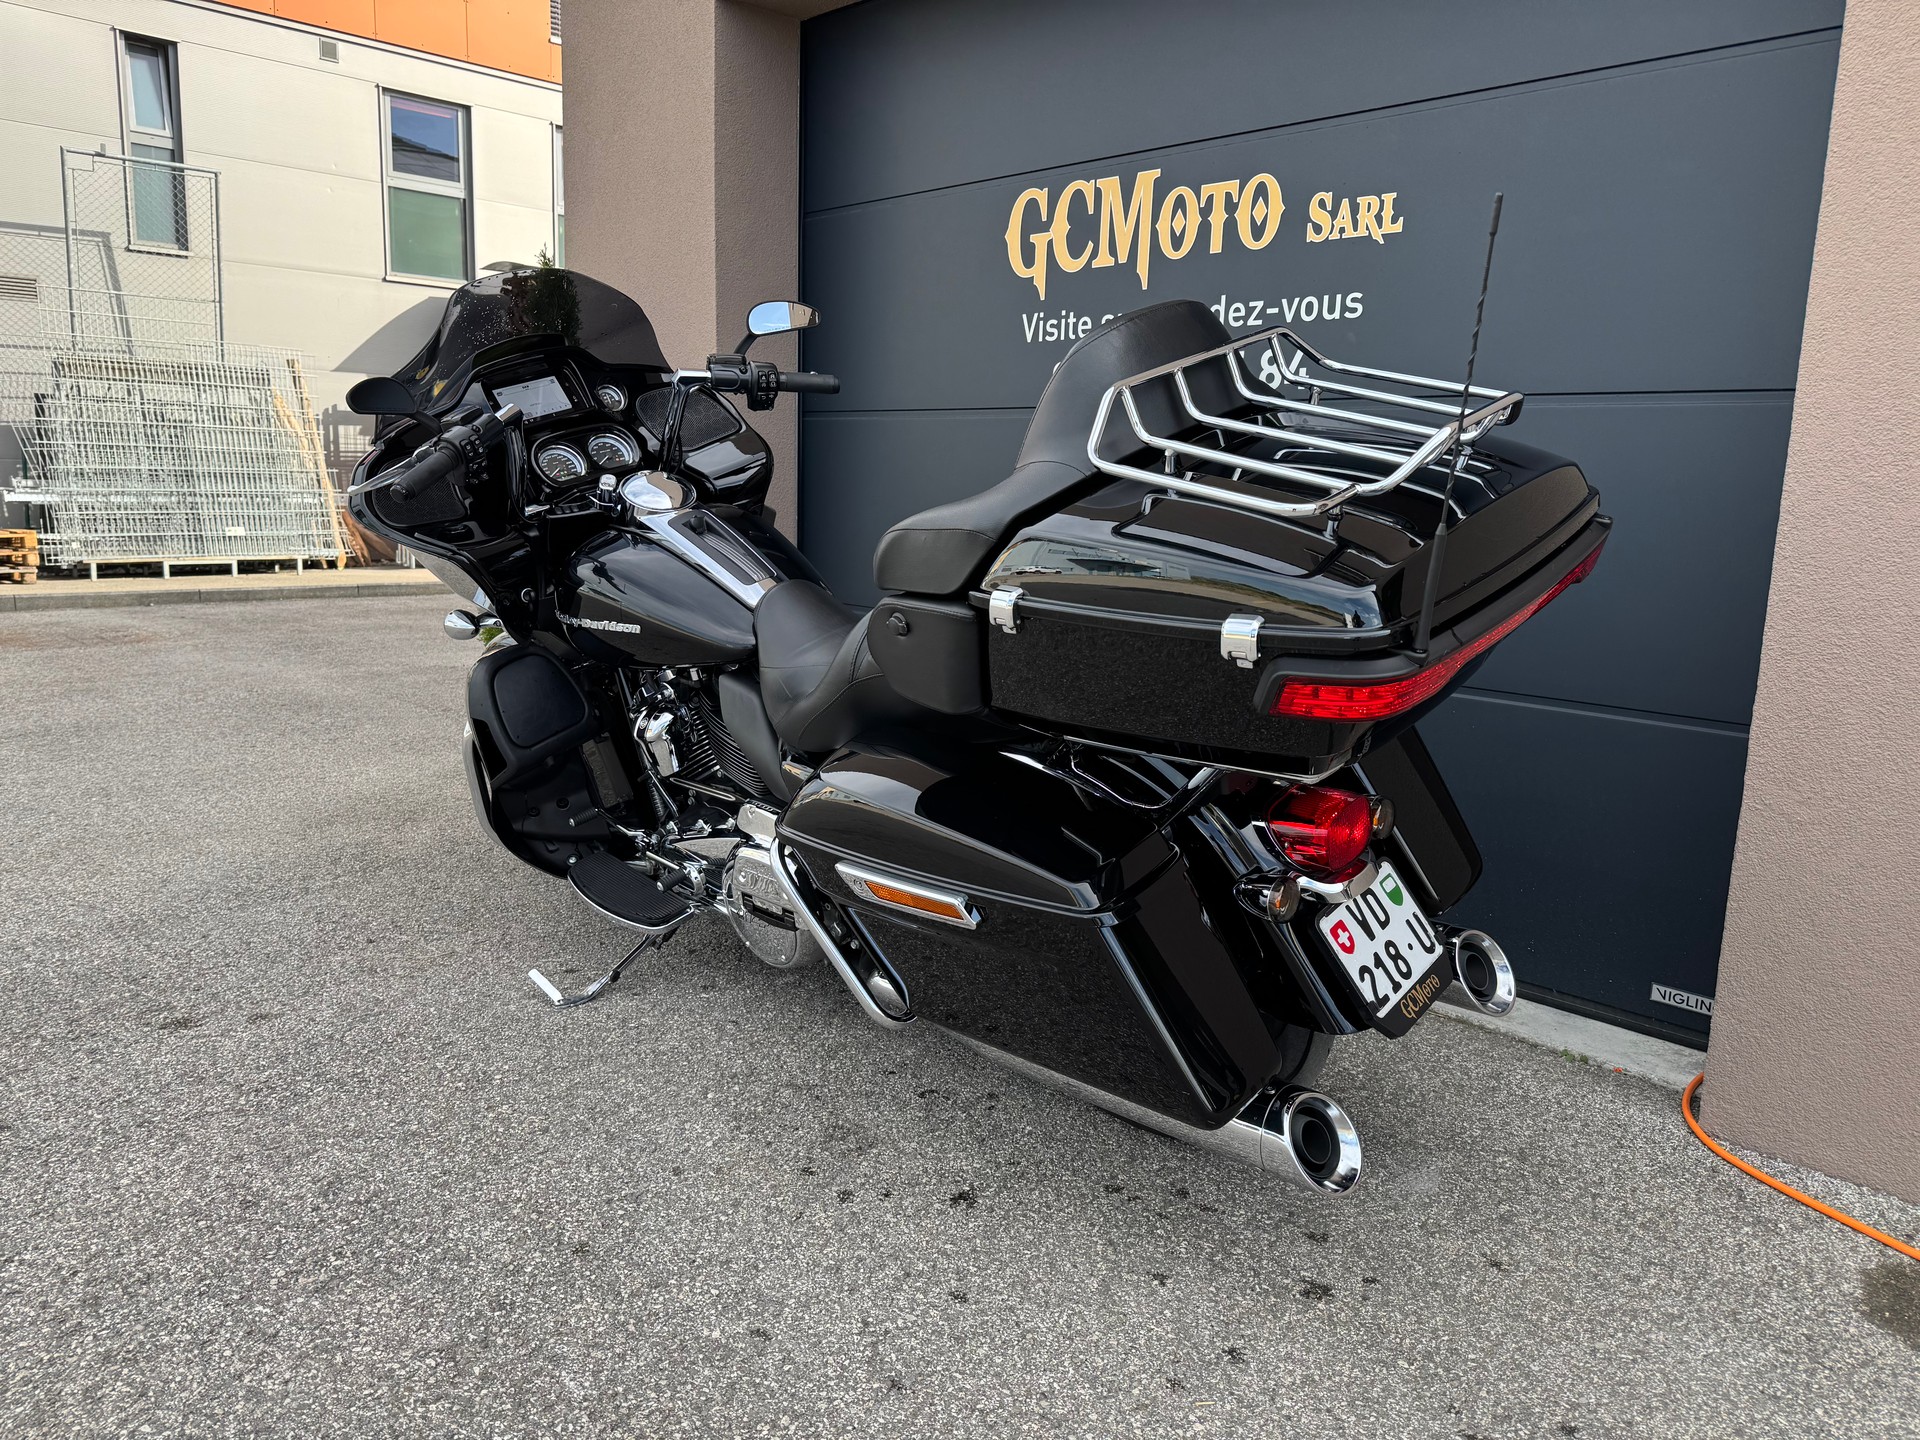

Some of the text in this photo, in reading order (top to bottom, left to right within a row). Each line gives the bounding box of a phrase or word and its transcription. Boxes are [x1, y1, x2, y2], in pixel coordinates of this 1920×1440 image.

[1021, 291, 1364, 343] Visite dez-vous
[1345, 887, 1391, 942] VD
[1656, 986, 1714, 1013] VIGLIN
